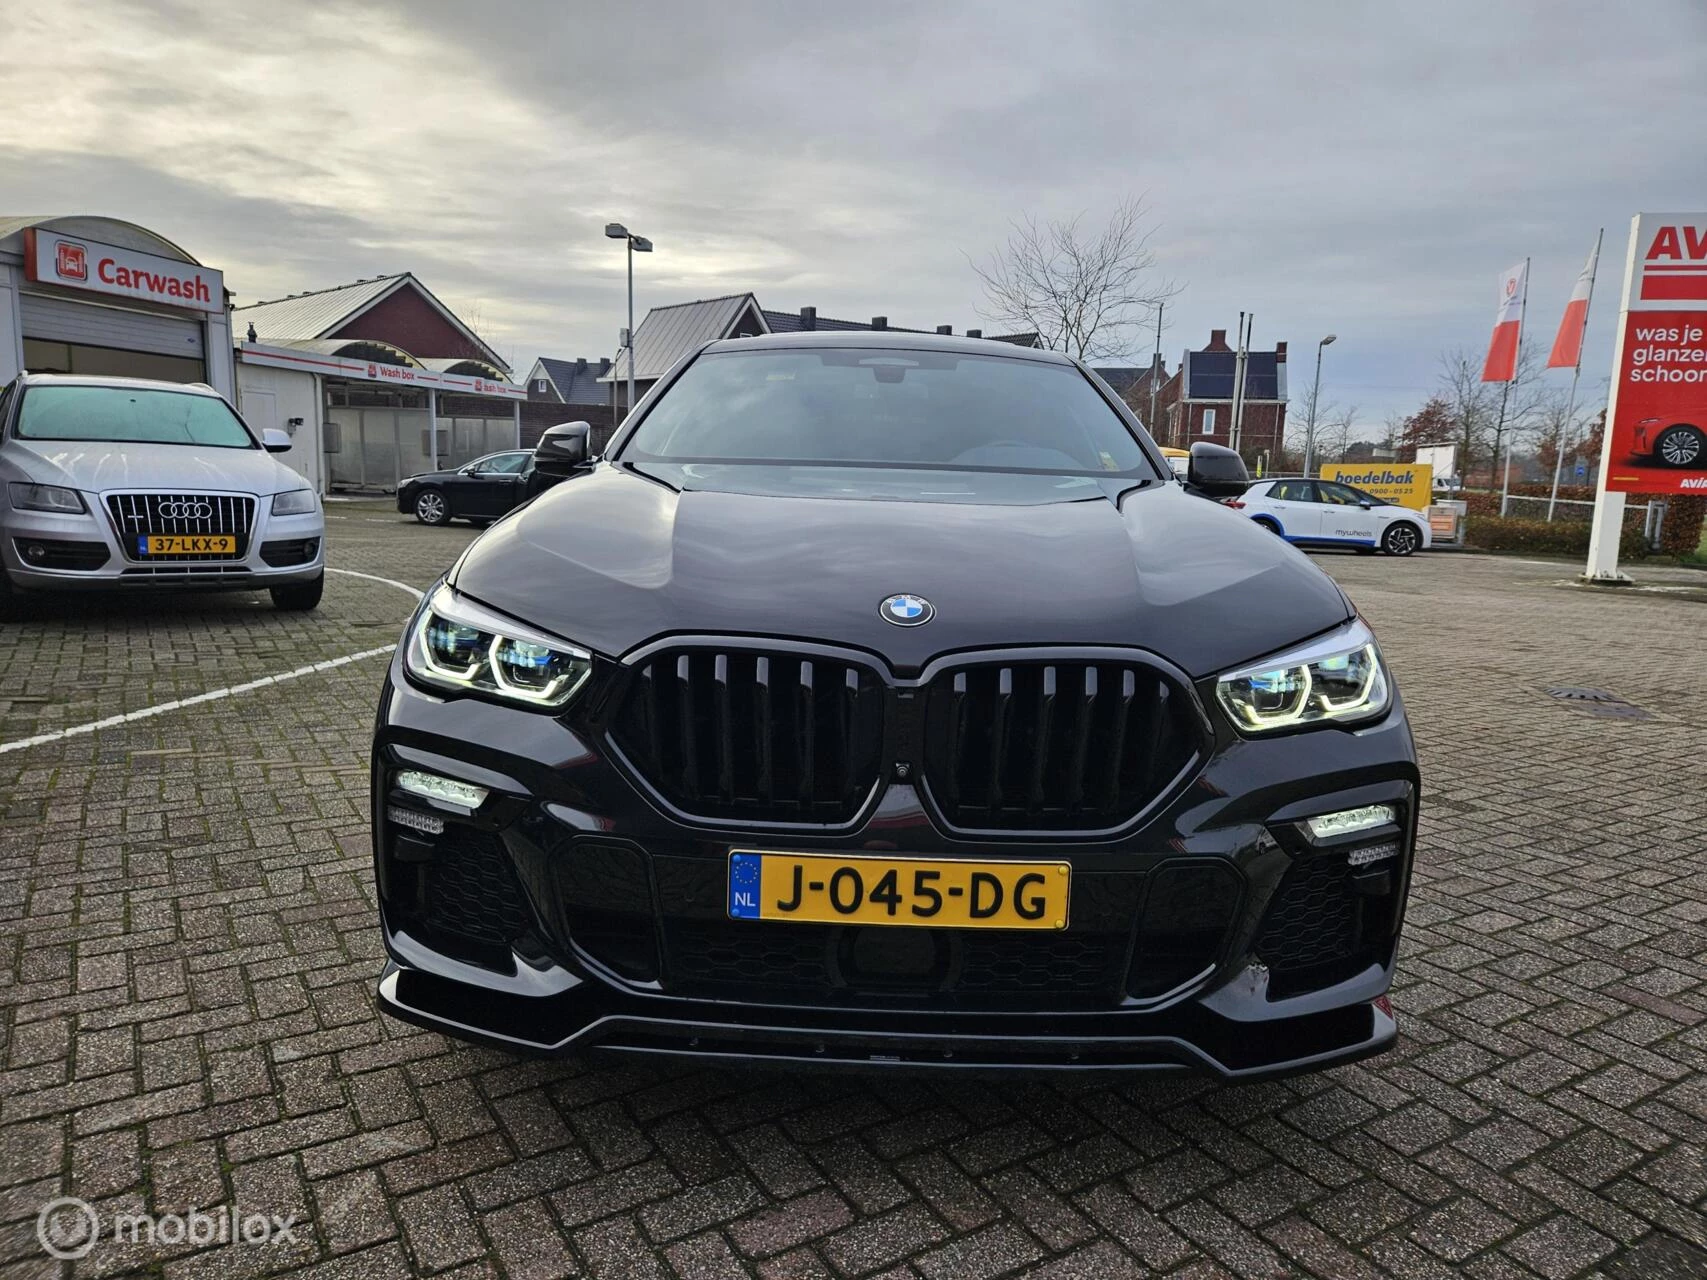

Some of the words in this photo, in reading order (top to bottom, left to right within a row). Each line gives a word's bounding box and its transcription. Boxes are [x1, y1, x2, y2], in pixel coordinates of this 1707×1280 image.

[98, 258, 211, 303] Carwash
[1636, 328, 1679, 341] was
[1680, 324, 1703, 346] je
[1633, 344, 1707, 366] glanze
[380, 366, 400, 378] Wash
[402, 372, 415, 381] box
[1336, 471, 1413, 484] boedelbak
[155, 538, 228, 551] 37-LKX-9
[734, 891, 756, 907] NL
[777, 864, 1046, 920] J-045-DG
